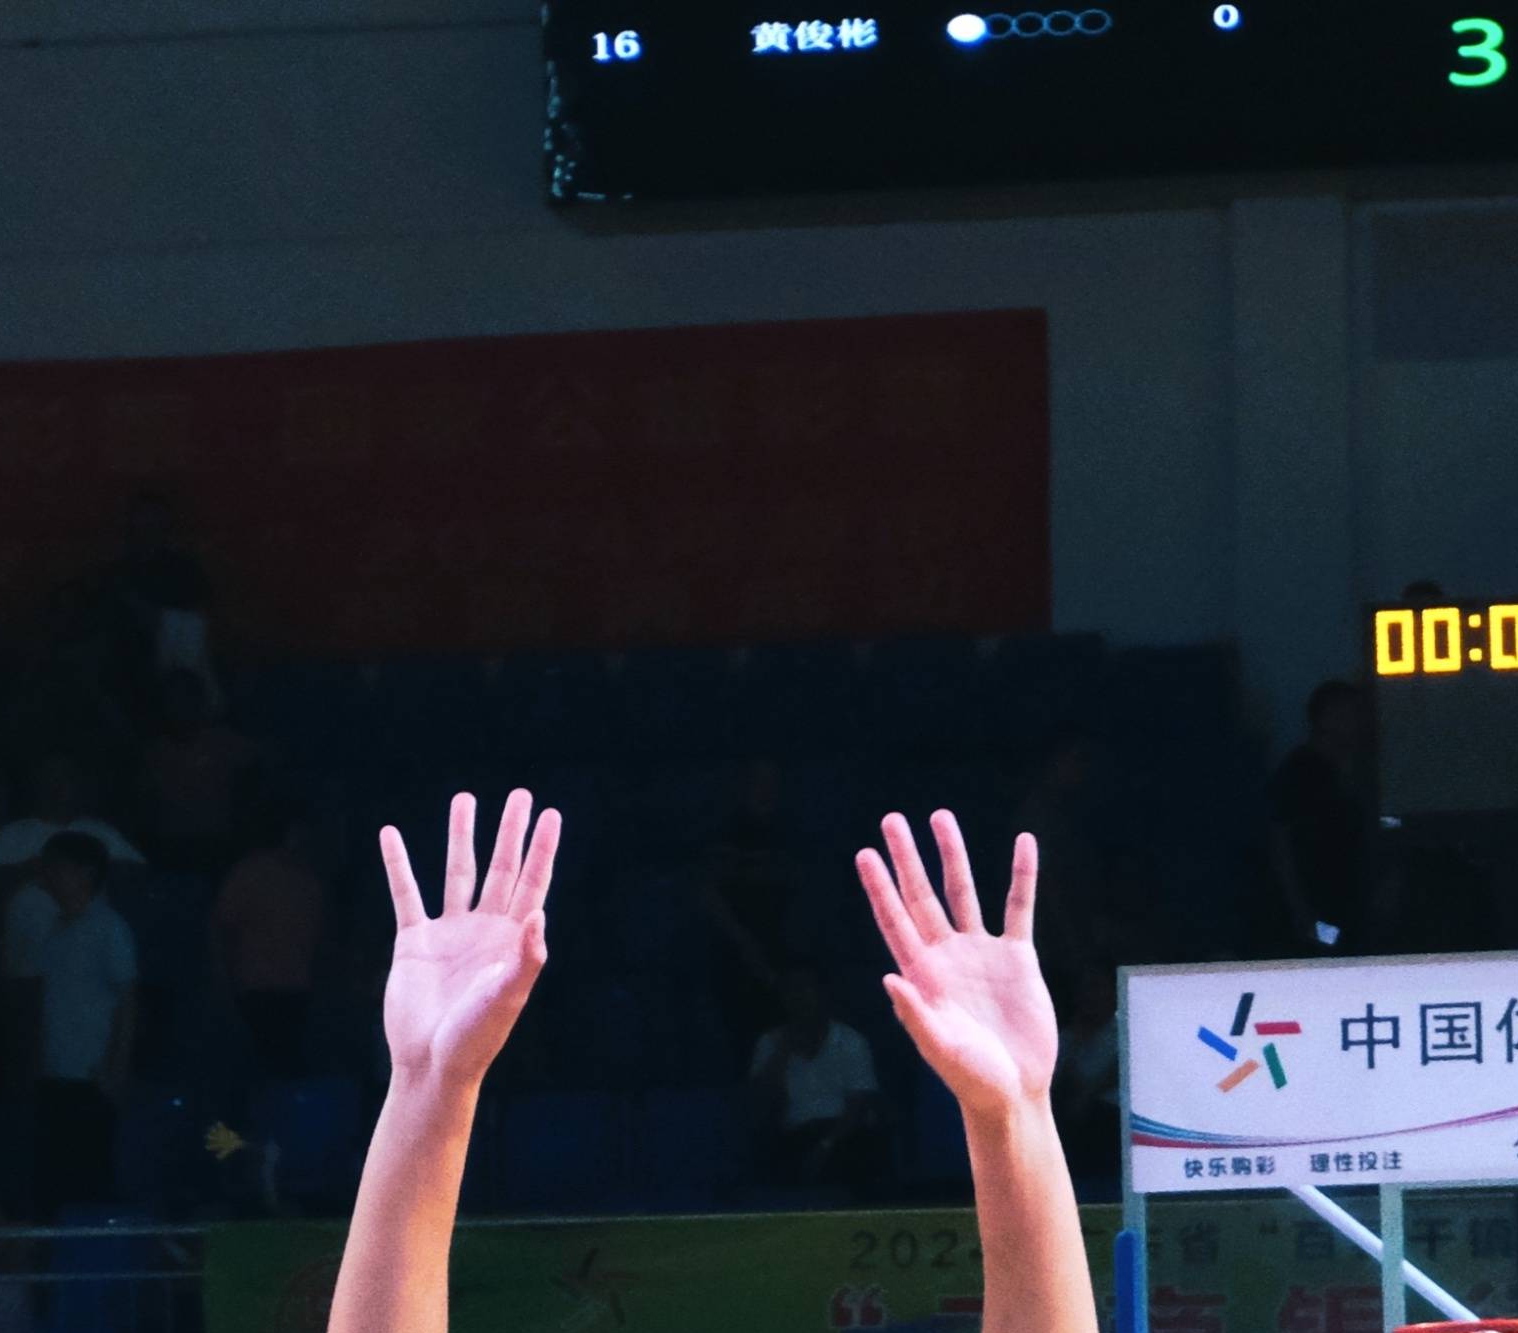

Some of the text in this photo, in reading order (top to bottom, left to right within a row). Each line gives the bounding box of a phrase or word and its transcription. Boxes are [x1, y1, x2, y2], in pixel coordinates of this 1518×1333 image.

[593, 31, 641, 61] 16
[1449, 17, 1507, 87] 3
[1183, 1151, 1403, 1178] 快乐购彩 理性投注
